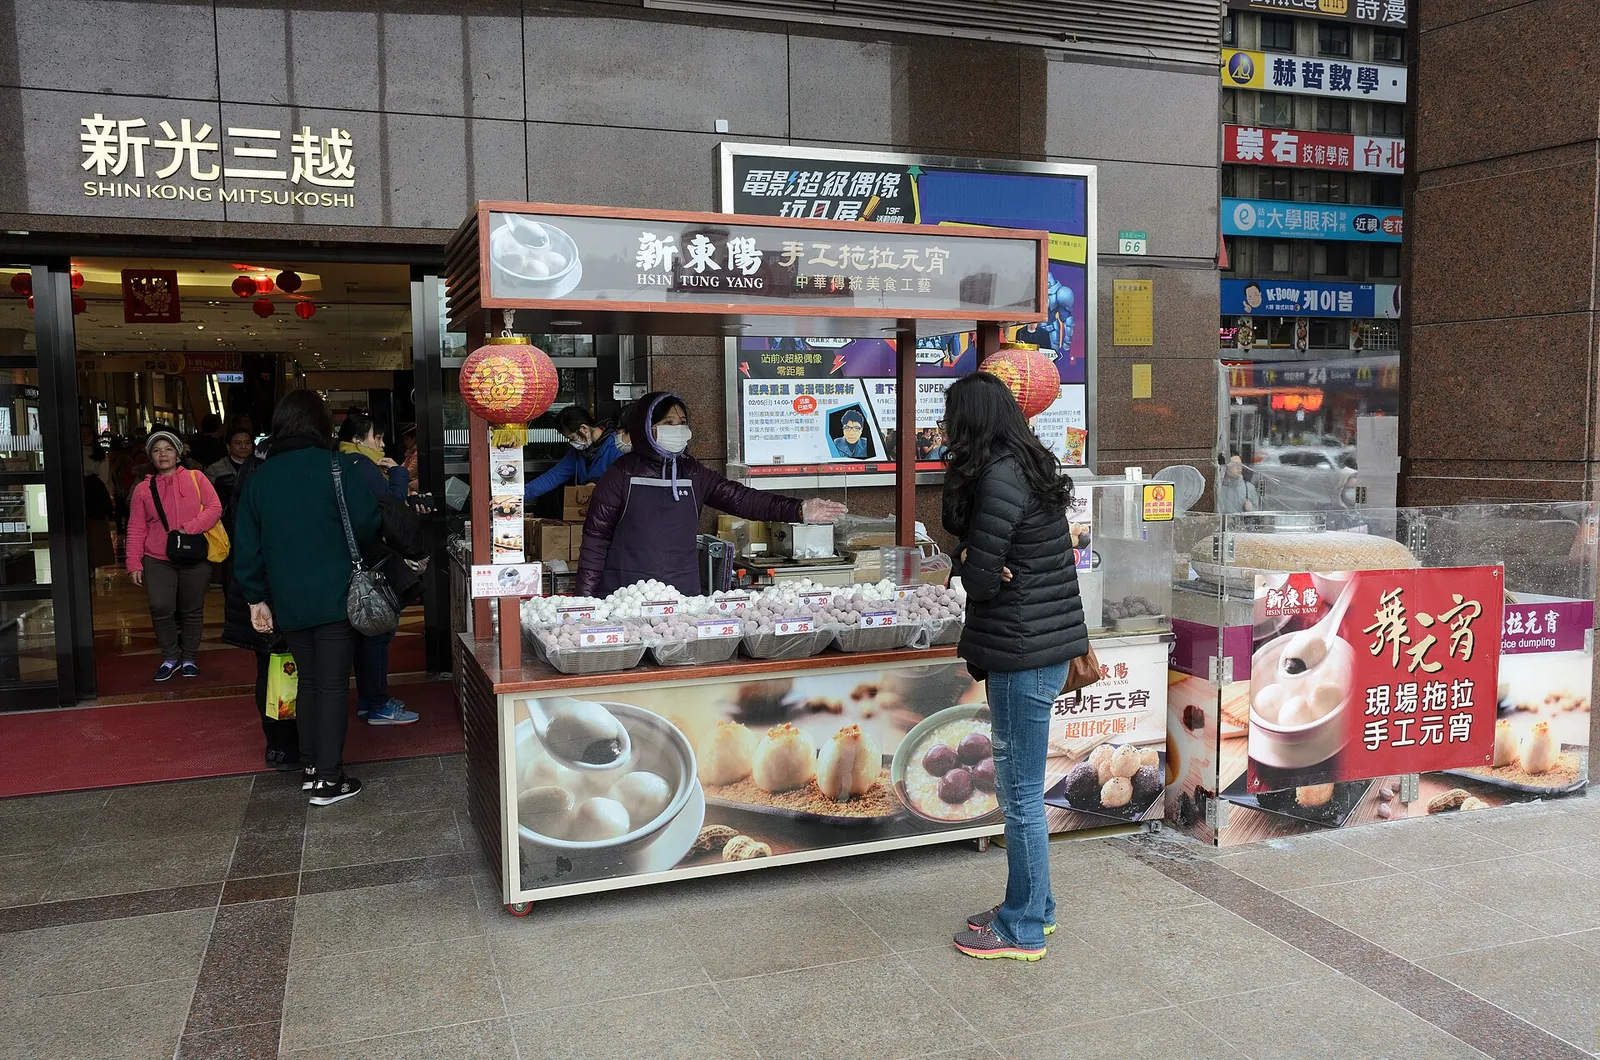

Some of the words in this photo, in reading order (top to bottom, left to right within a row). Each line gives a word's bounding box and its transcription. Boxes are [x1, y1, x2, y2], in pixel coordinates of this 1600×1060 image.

[1273, 58, 1379, 94] 赫哲數學
[80, 112, 356, 188] 新光三越
[1236, 128, 1298, 163] 崇右
[1302, 144, 1349, 166] 技術學院
[1364, 139, 1404, 168] 台北
[84, 181, 140, 198] SHIN
[146, 184, 212, 202] KONG
[219, 188, 355, 208] MITSUKOSHI
[742, 170, 901, 198] 電影超級偶像
[1266, 208, 1338, 232] 大學眼科
[1355, 218, 1378, 232] 近視
[635, 232, 764, 276] 新東陽
[778, 240, 950, 276] 手工拖拉元宵
[1125, 242, 1140, 252] 66
[636, 274, 672, 286] HSIN
[680, 275, 720, 288] TUNG
[726, 276, 764, 289] YANG
[795, 272, 933, 293] 中華傳統美食工藝
[1266, 288, 1300, 302] K-BOOM
[1303, 290, 1353, 312] 케이봄
[1308, 368, 1326, 384] 24
[748, 384, 789, 395] 經典重溫
[919, 384, 944, 393] SUPER
[1266, 587, 1319, 609] 新東陽
[722, 627, 734, 635] 25
[798, 624, 808, 632] 25
[1362, 586, 1482, 673] 舞元宵
[1502, 610, 1560, 636] 拉元宵
[606, 635, 618, 643] 25
[1518, 638, 1555, 648] dumpling
[1364, 678, 1474, 717] 現場拖拉
[1065, 716, 1138, 738] 超好吃喔!
[1363, 713, 1473, 751] 手工元宵
